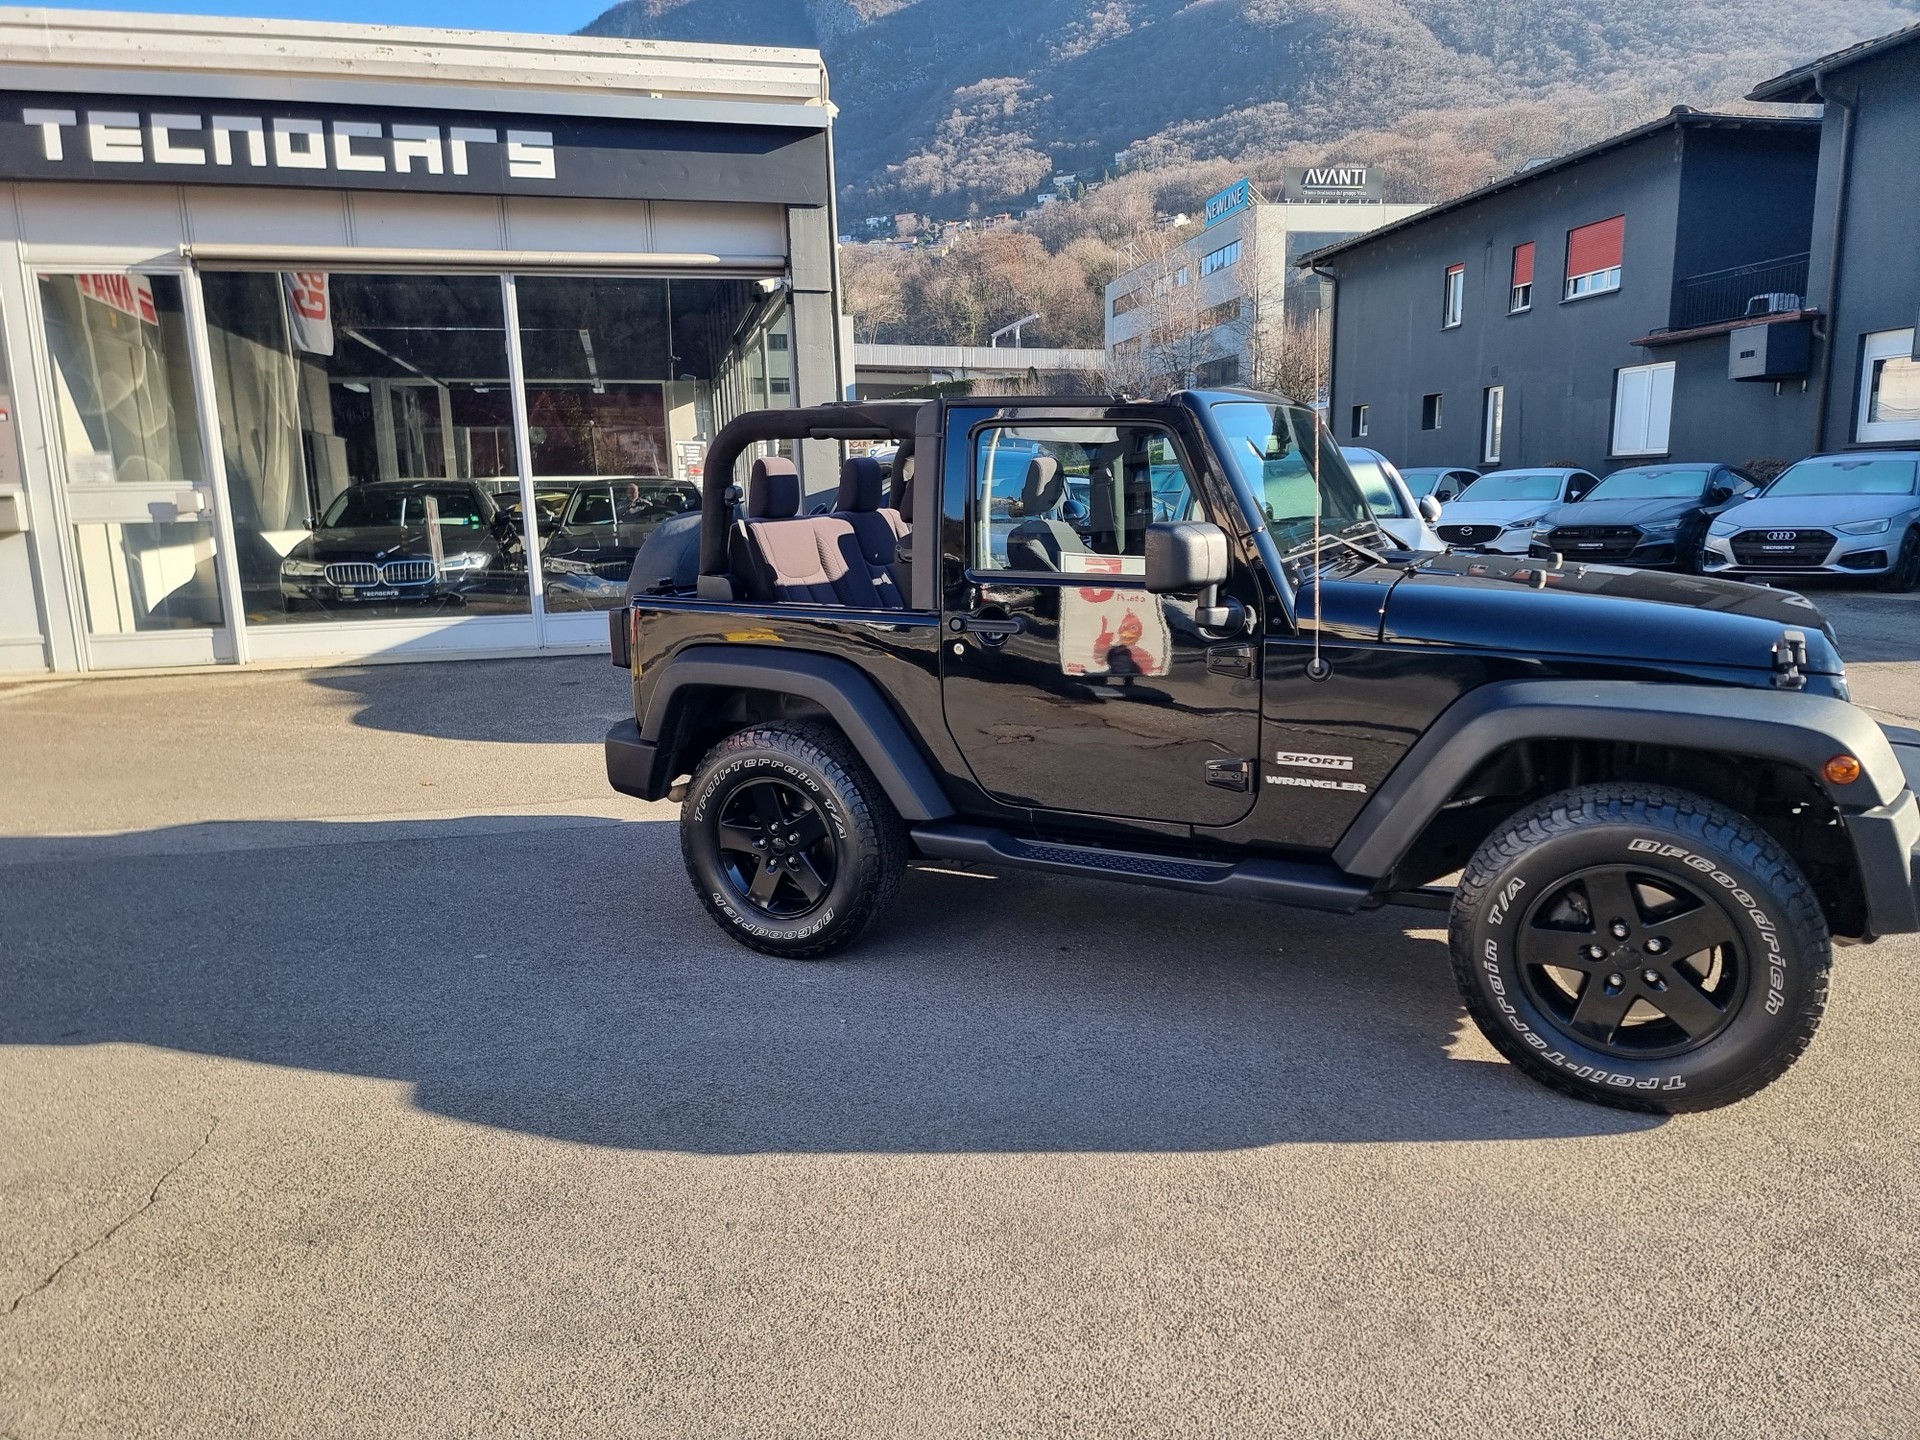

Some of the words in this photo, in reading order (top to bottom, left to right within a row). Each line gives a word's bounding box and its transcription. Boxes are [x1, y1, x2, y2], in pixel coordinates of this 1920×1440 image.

[1304, 168, 1366, 184] AVANTI
[1205, 186, 1244, 222] NEWLINE
[1282, 755, 1349, 766] SPORT
[1265, 775, 1368, 793] WRANGLER
[824, 798, 848, 840] T/A
[1488, 876, 1526, 926] T/A
